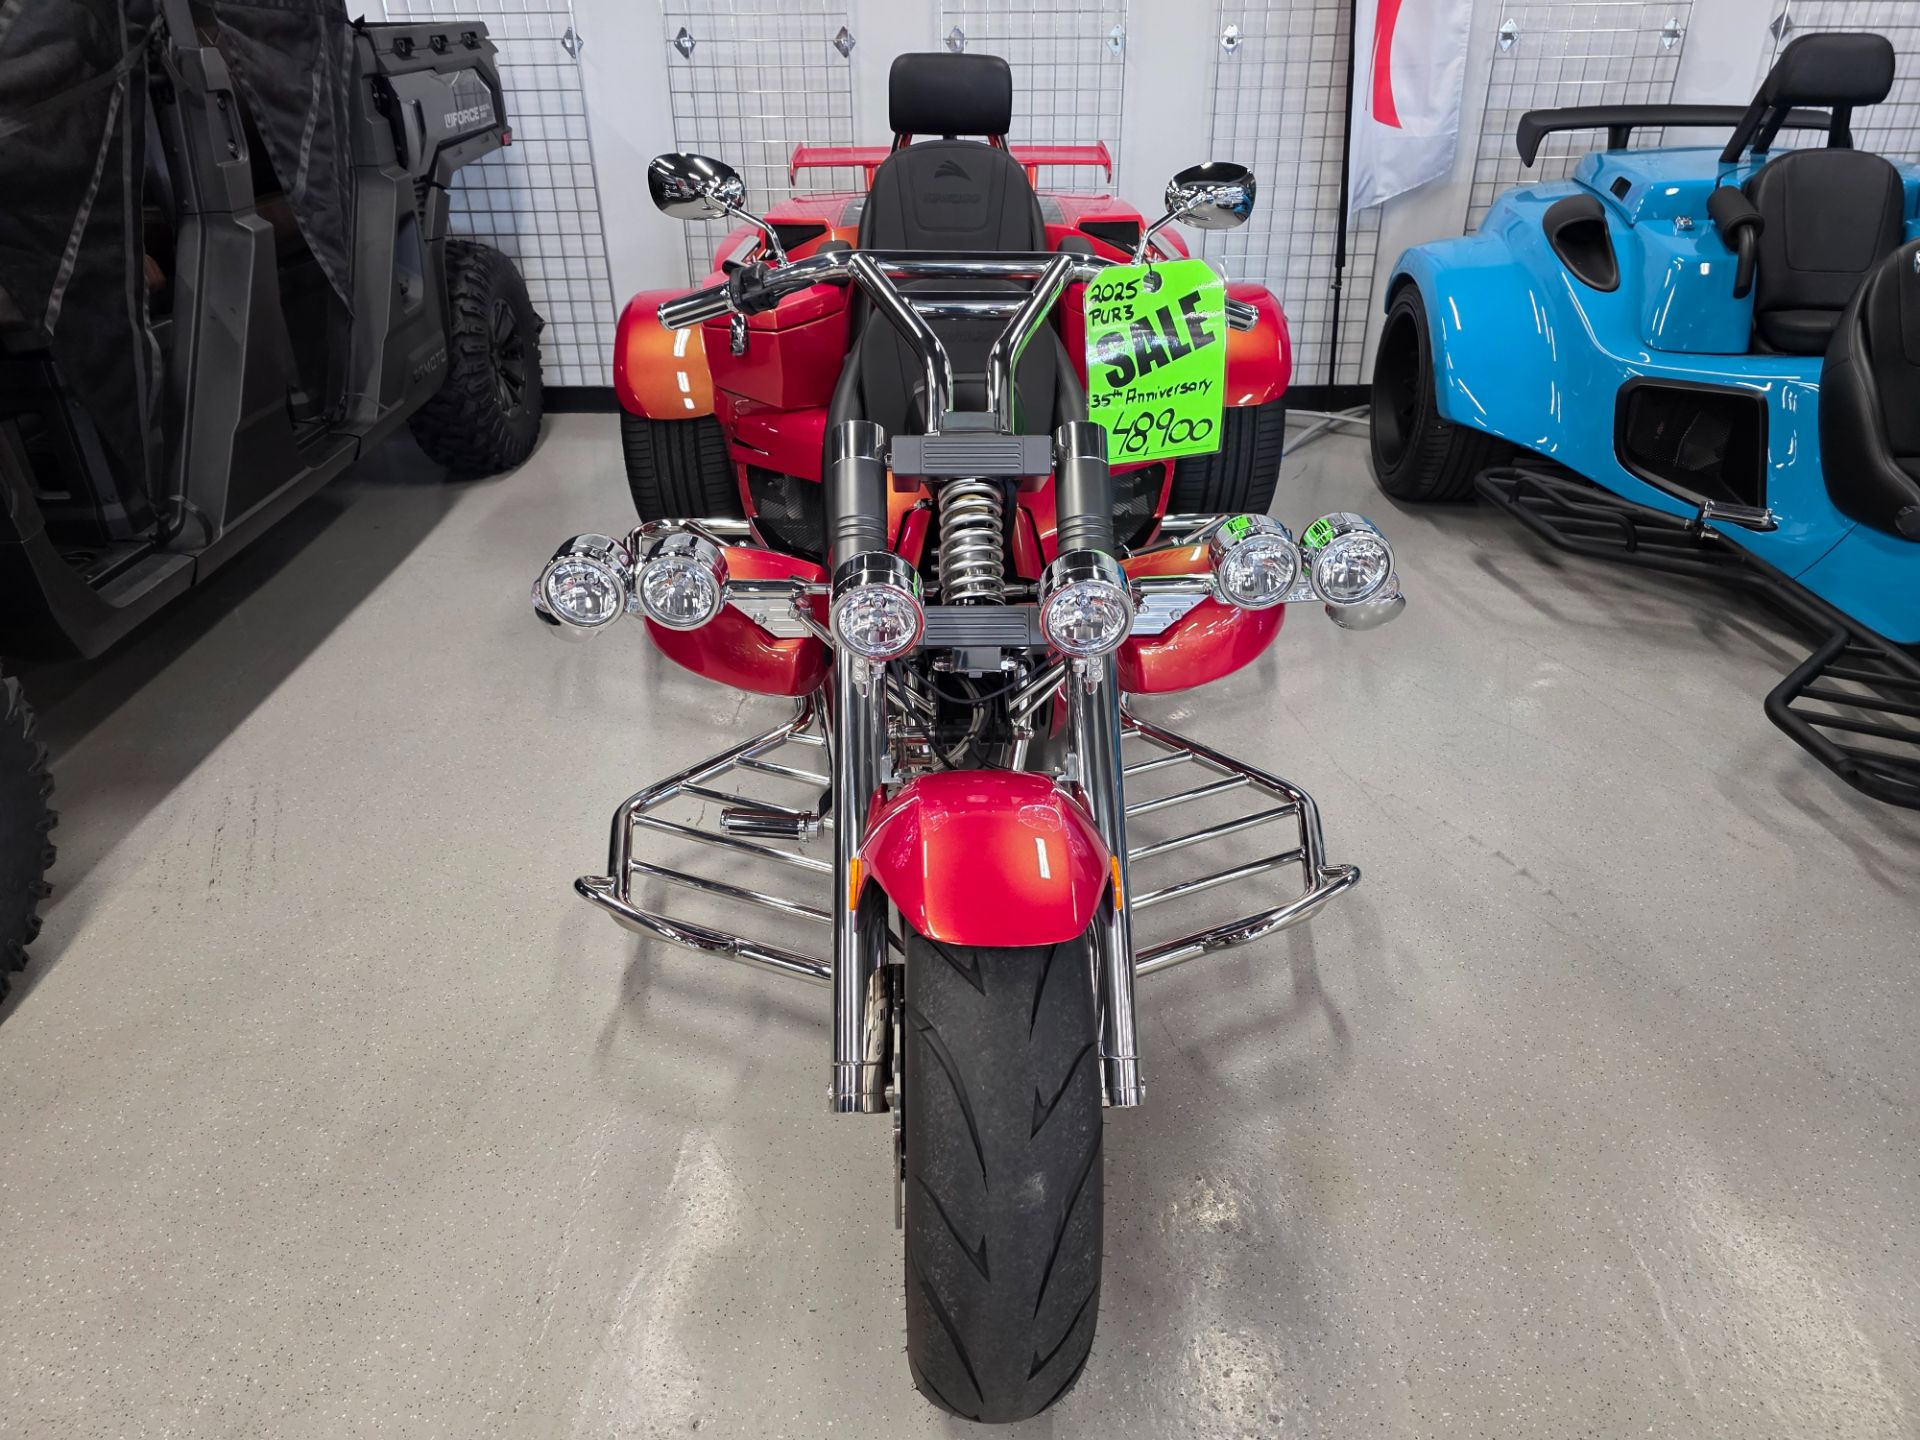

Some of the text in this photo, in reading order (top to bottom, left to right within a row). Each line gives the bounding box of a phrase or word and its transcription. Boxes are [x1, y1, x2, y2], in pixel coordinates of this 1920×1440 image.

[1089, 278, 1141, 303] 2025
[1096, 290, 1216, 388] SALE
[1090, 378, 1213, 408] 35th Anniversary
[1112, 408, 1213, 456] 48,900
